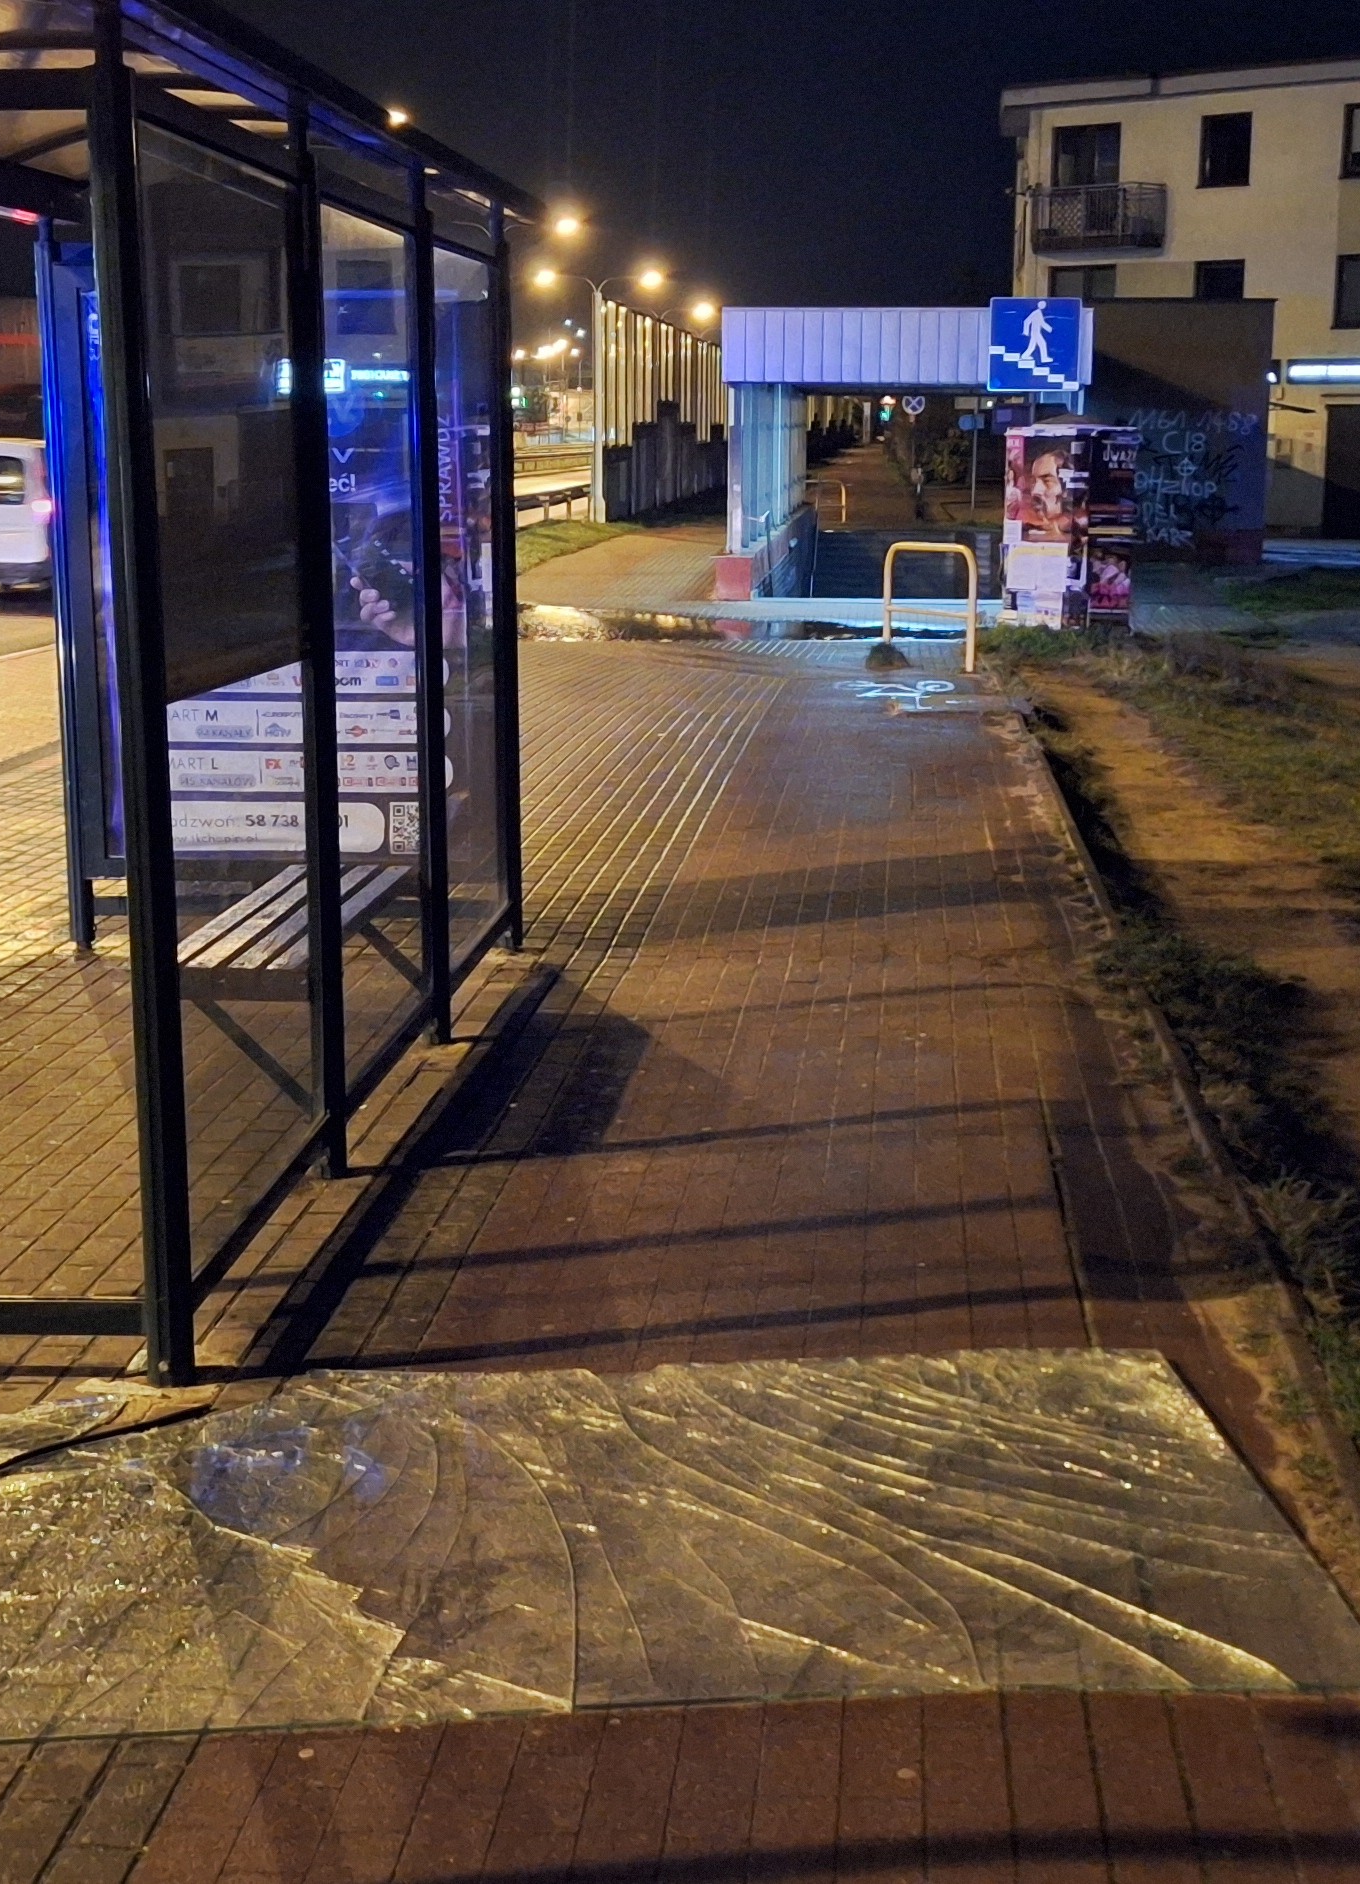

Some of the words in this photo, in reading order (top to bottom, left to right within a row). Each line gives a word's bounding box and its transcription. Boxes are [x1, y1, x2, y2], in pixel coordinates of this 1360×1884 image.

[329, 472, 356, 493] eć!
[168, 708, 199, 722] ART
[205, 709, 219, 722] M
[169, 756, 206, 771] MART
[211, 757, 220, 771] L
[172, 813, 240, 828] adzwoń:
[245, 814, 267, 828] 58
[270, 814, 300, 828] 738
